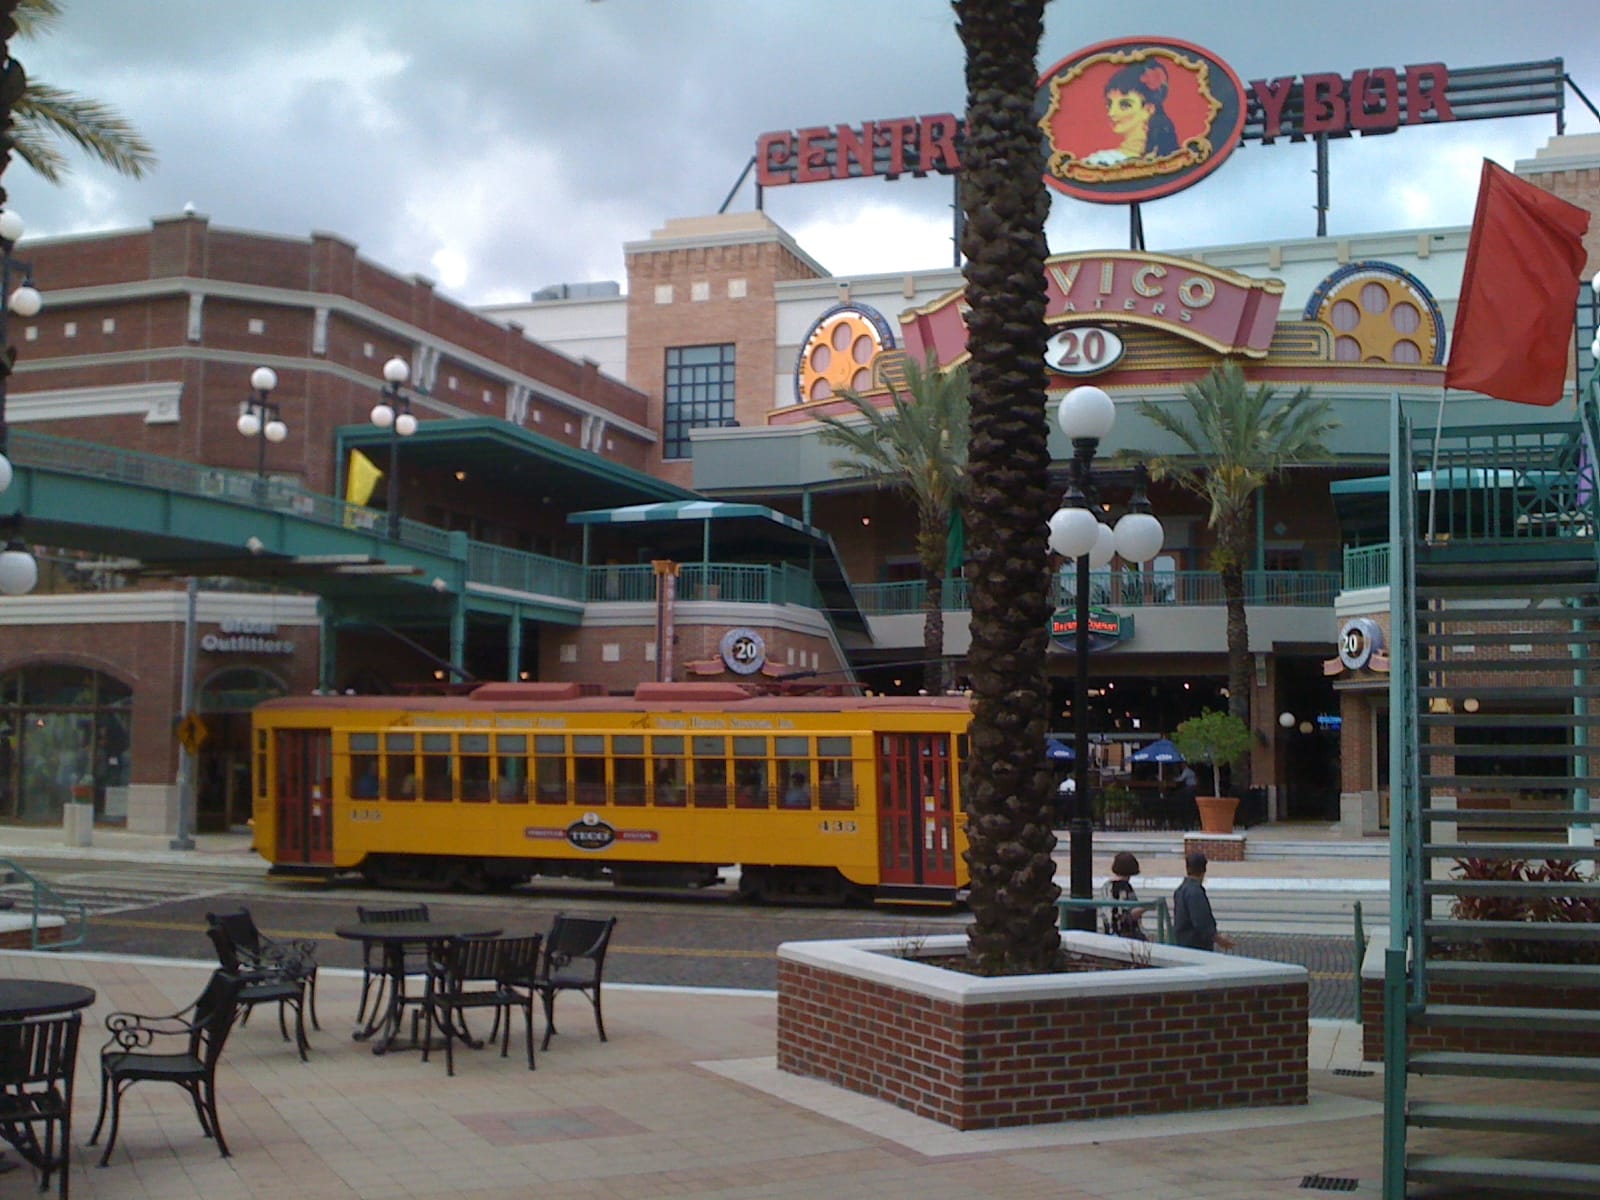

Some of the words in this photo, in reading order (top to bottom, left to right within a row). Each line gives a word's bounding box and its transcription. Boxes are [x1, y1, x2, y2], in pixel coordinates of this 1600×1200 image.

[757, 113, 970, 186] CENTR
[1249, 63, 1456, 137] YBOR
[1064, 299, 1193, 322] ATERS
[1057, 330, 1106, 366] 20
[202, 634, 295, 653] Outfitters
[735, 642, 757, 659] 20
[1342, 634, 1358, 653] 20
